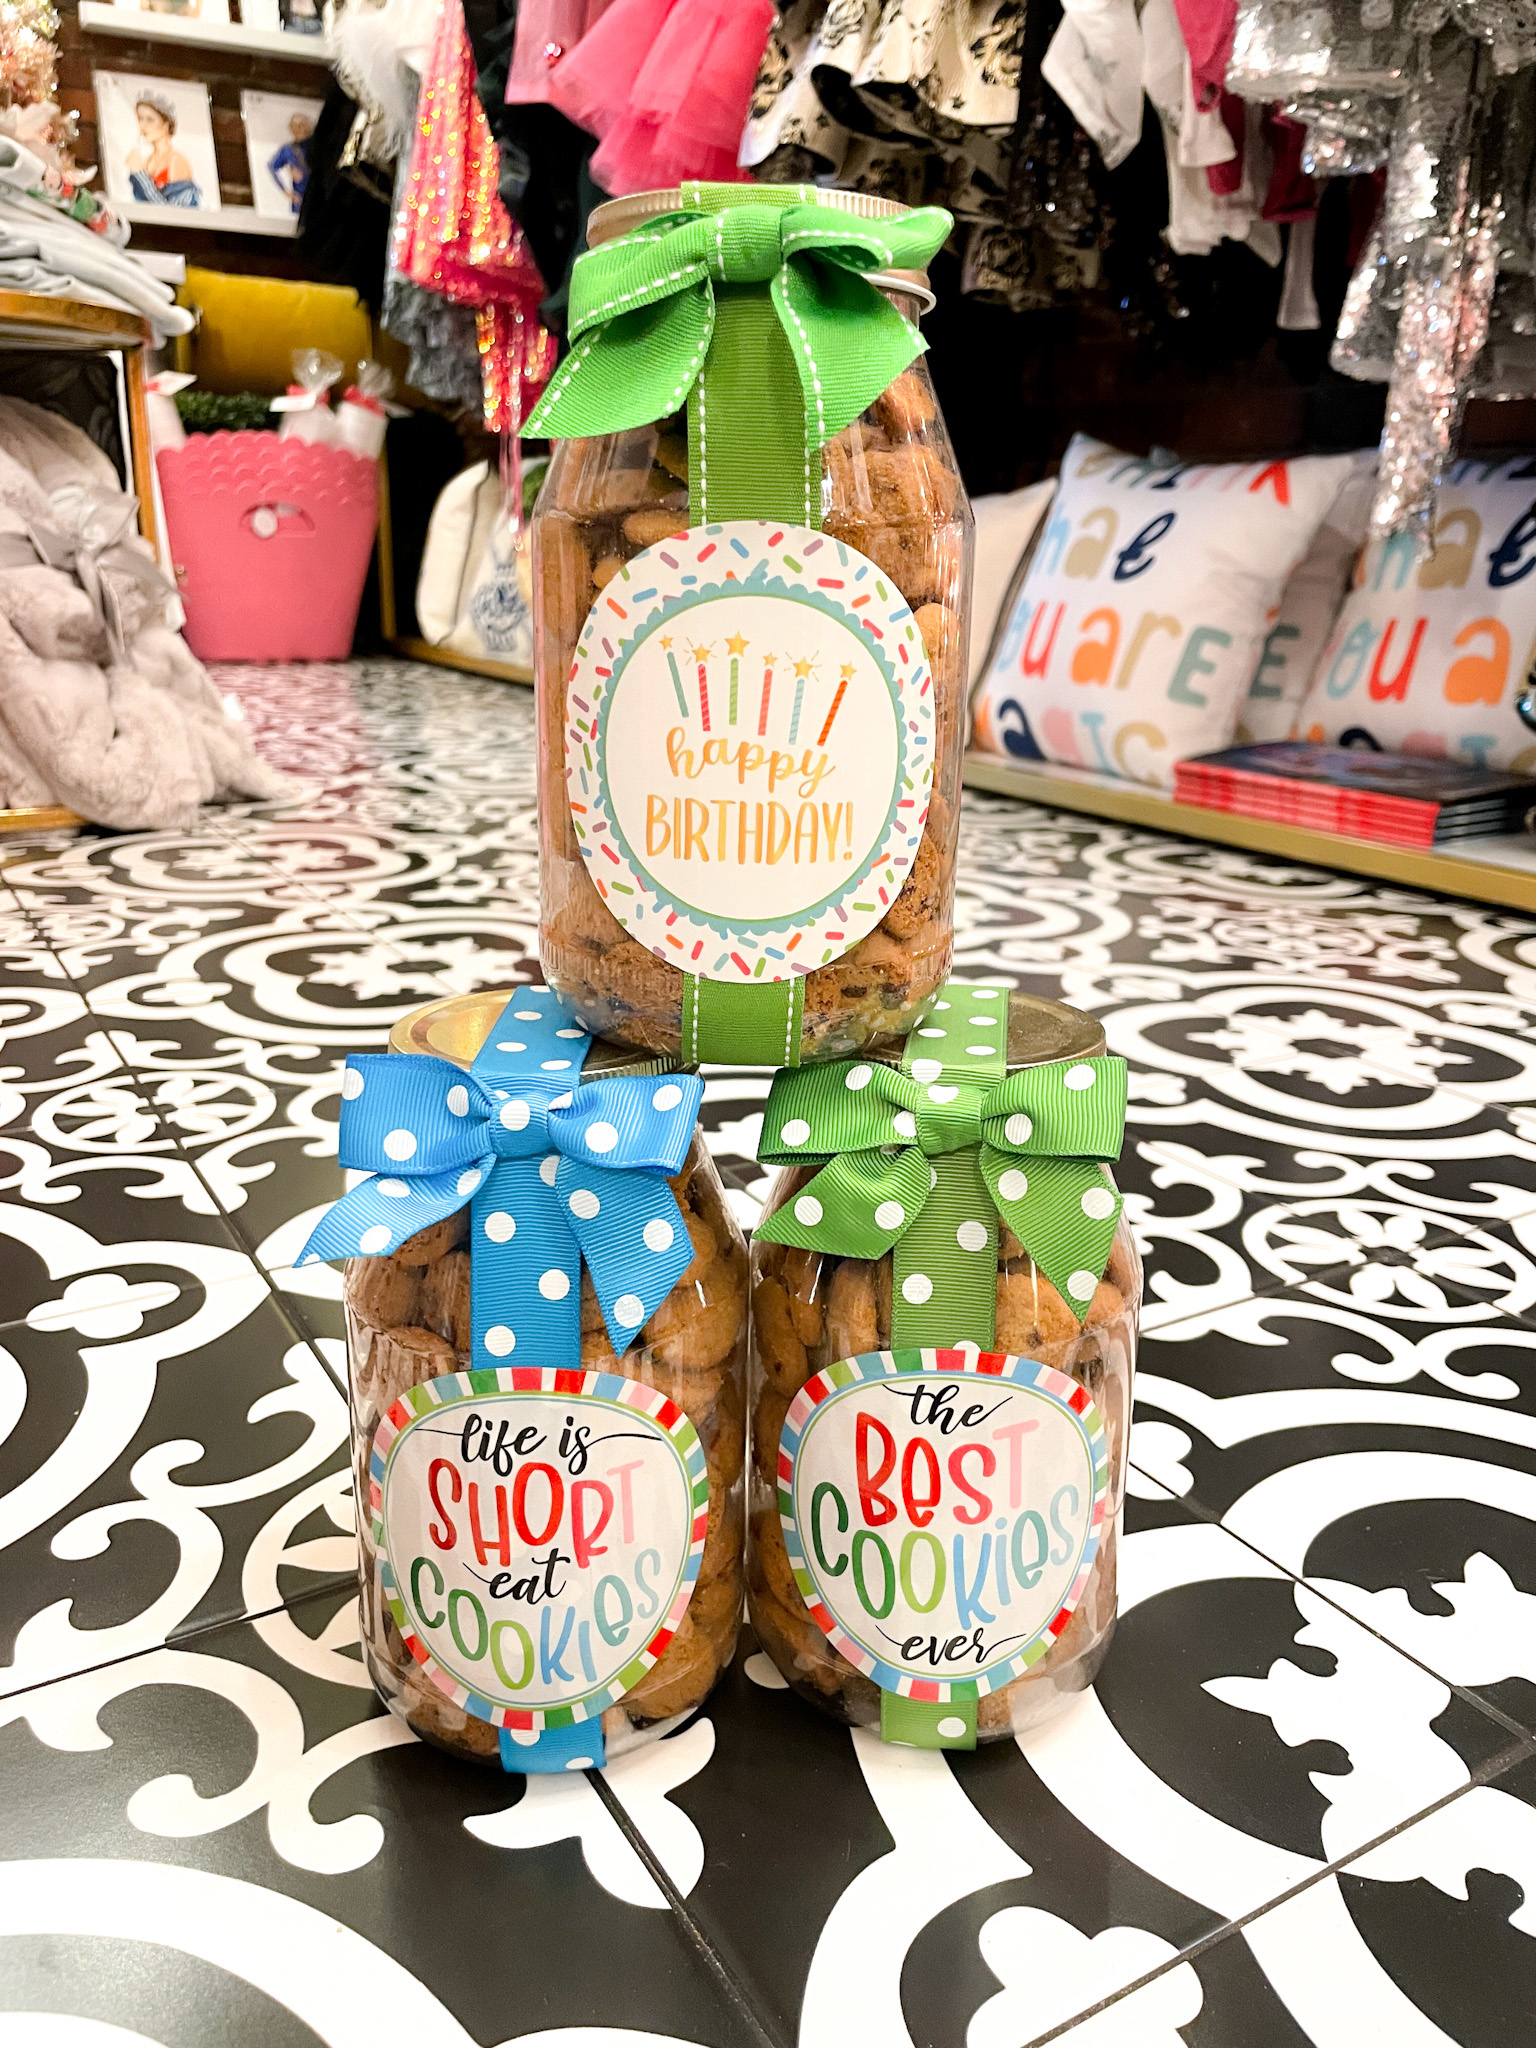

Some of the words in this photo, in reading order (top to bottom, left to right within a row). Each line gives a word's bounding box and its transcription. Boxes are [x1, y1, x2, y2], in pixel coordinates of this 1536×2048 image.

[666, 726, 836, 798] happy
[645, 794, 853, 865] BIRTHDAY!
[882, 1384, 1013, 1435] the
[414, 1413, 547, 1477] life
[428, 1458, 645, 1569] SHORT
[463, 1548, 570, 1605] eat
[875, 1624, 1026, 1666] ever
